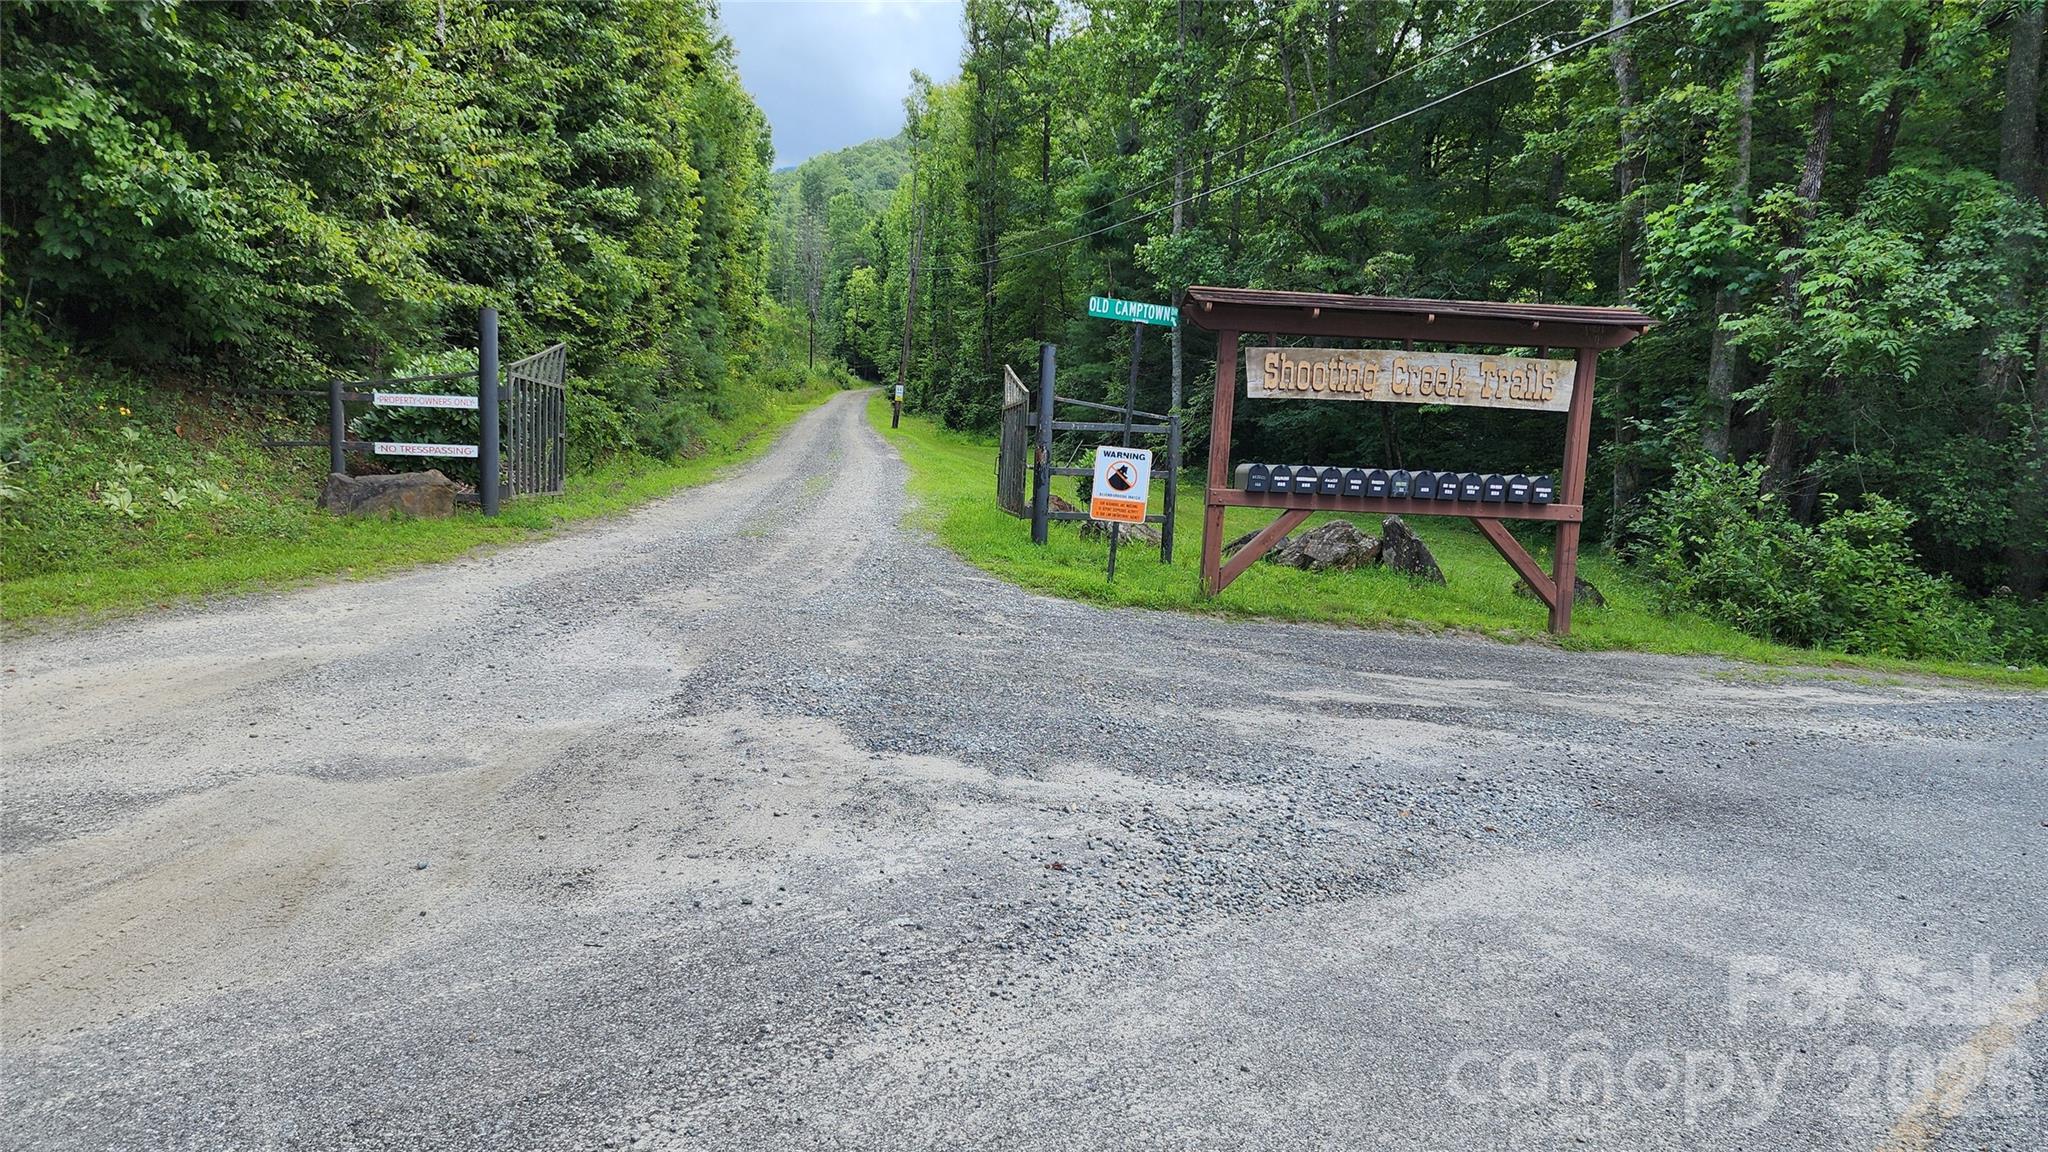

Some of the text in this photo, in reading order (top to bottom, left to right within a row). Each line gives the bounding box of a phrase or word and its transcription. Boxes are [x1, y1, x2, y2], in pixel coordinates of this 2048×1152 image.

[1089, 296, 1109, 313] OLD
[1115, 301, 1171, 321] CAMPTOWN
[1264, 352, 1556, 401] Shooting Creek Trails
[381, 445, 472, 455] NO TRESSPASSING
[1103, 450, 1146, 460] WARNING
